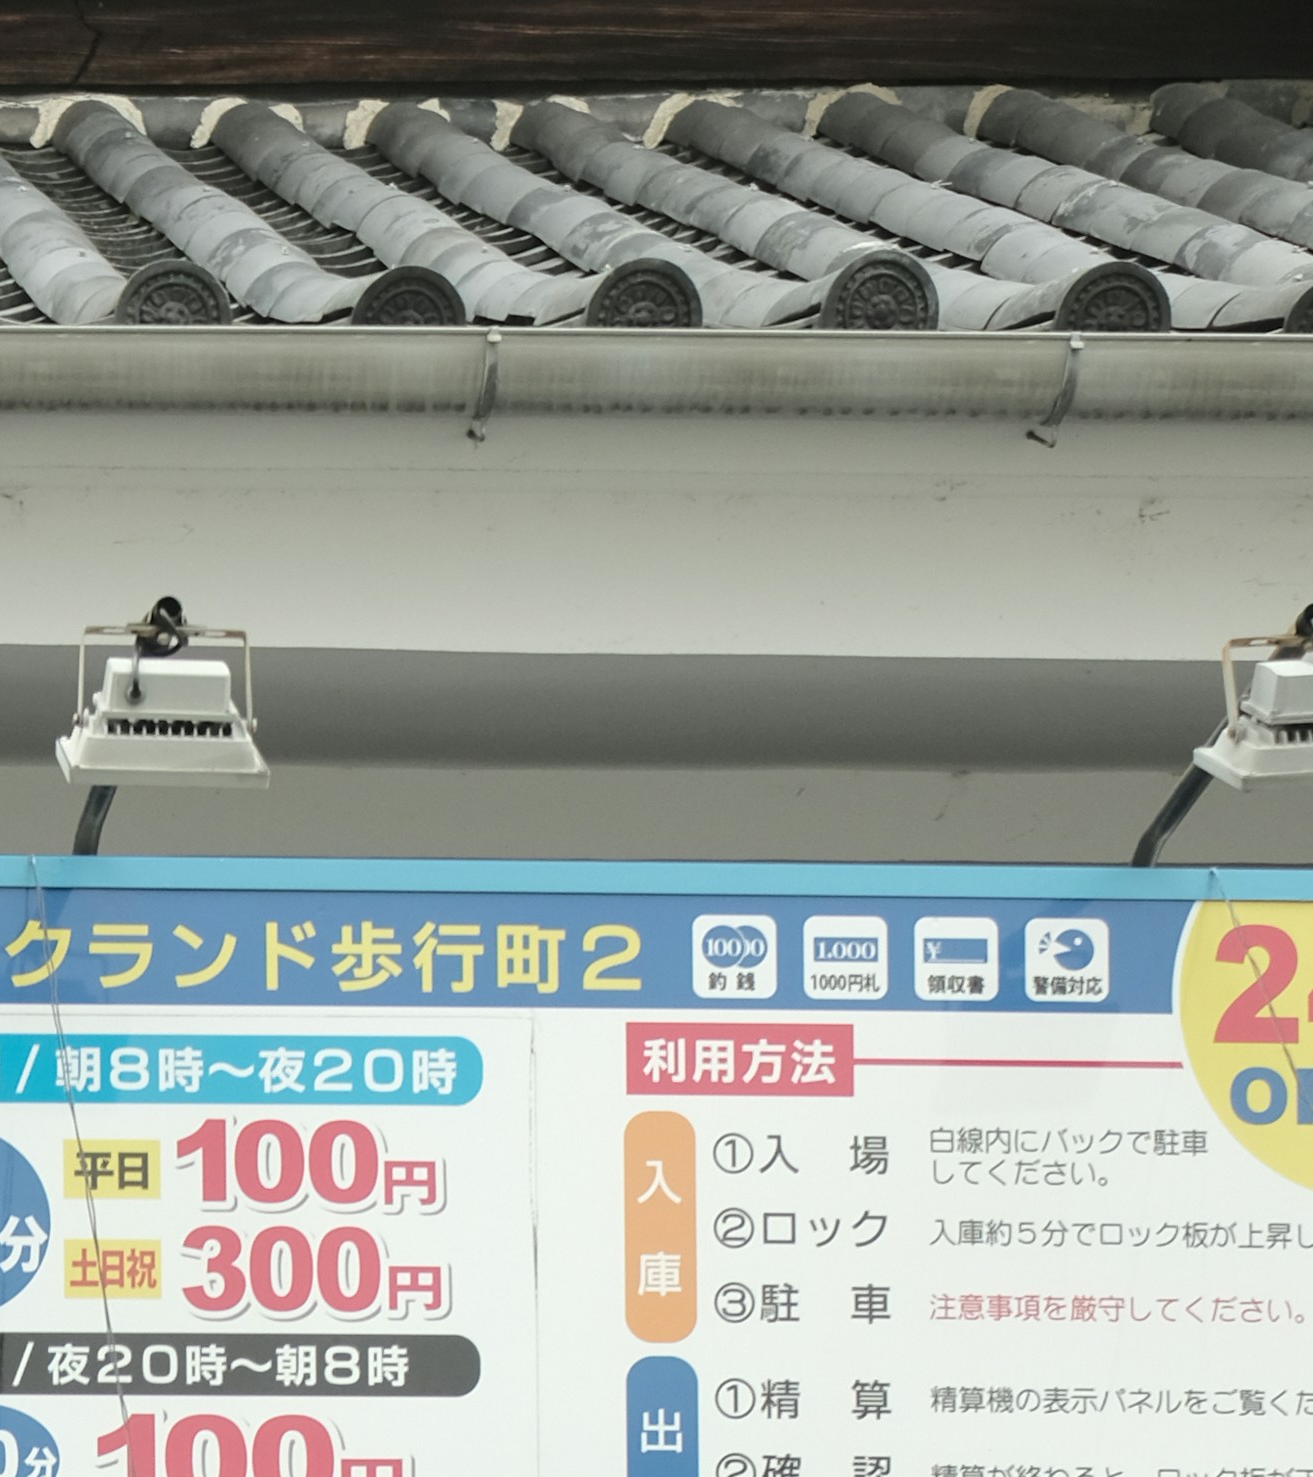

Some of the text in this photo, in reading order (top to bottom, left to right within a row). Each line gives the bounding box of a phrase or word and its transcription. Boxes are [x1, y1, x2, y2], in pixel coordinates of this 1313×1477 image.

[811, 974, 879, 992] 1000円札
[927, 975, 985, 995] 領収書
[1032, 977, 1102, 997] 警備対応
[1213, 924, 1313, 1043] 2
[644, 1038, 835, 1083] 利用方法
[931, 1128, 1207, 1156] 白線内にバックで駐車
[75, 1148, 148, 1190] 平日
[933, 1160, 1107, 1186] してください。
[70, 1249, 157, 1288] 土日祝
[931, 1294, 1304, 1323] 注意事項を厳守してください。
